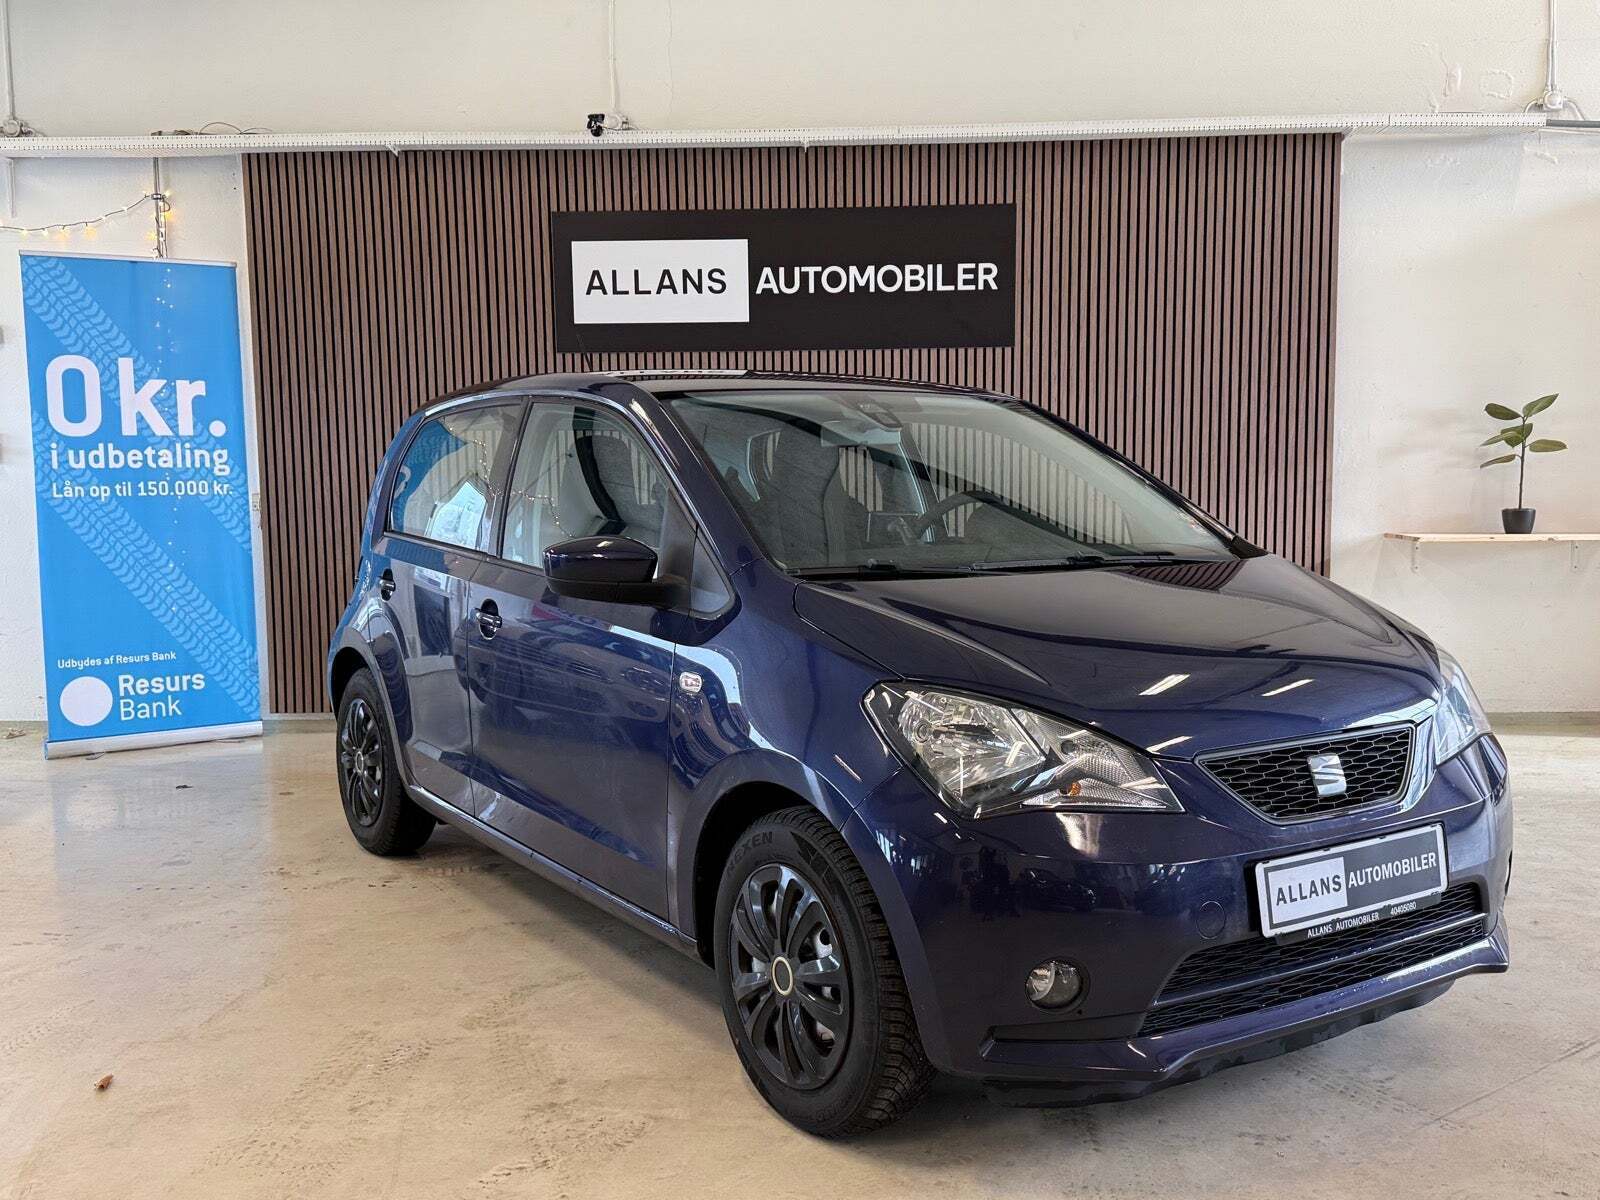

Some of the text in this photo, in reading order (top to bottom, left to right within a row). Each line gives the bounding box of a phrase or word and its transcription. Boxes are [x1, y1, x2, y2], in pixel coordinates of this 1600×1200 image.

[585, 262, 999, 297] ALLANS AUTOMOBILER
[45, 354, 228, 438] 0 kr.
[50, 442, 231, 477] i udbetaling
[52, 480, 233, 502] Lån op til 150.000 kr.
[57, 651, 177, 670] Udbydes af Resurs Bank
[117, 673, 206, 697] Resurs
[119, 695, 183, 721] Bank
[1275, 851, 1437, 907] ALLANS AUTOMOBILER
[1306, 924, 1333, 939] ALLANS
[1335, 912, 1380, 932] AUTOMOBILER
